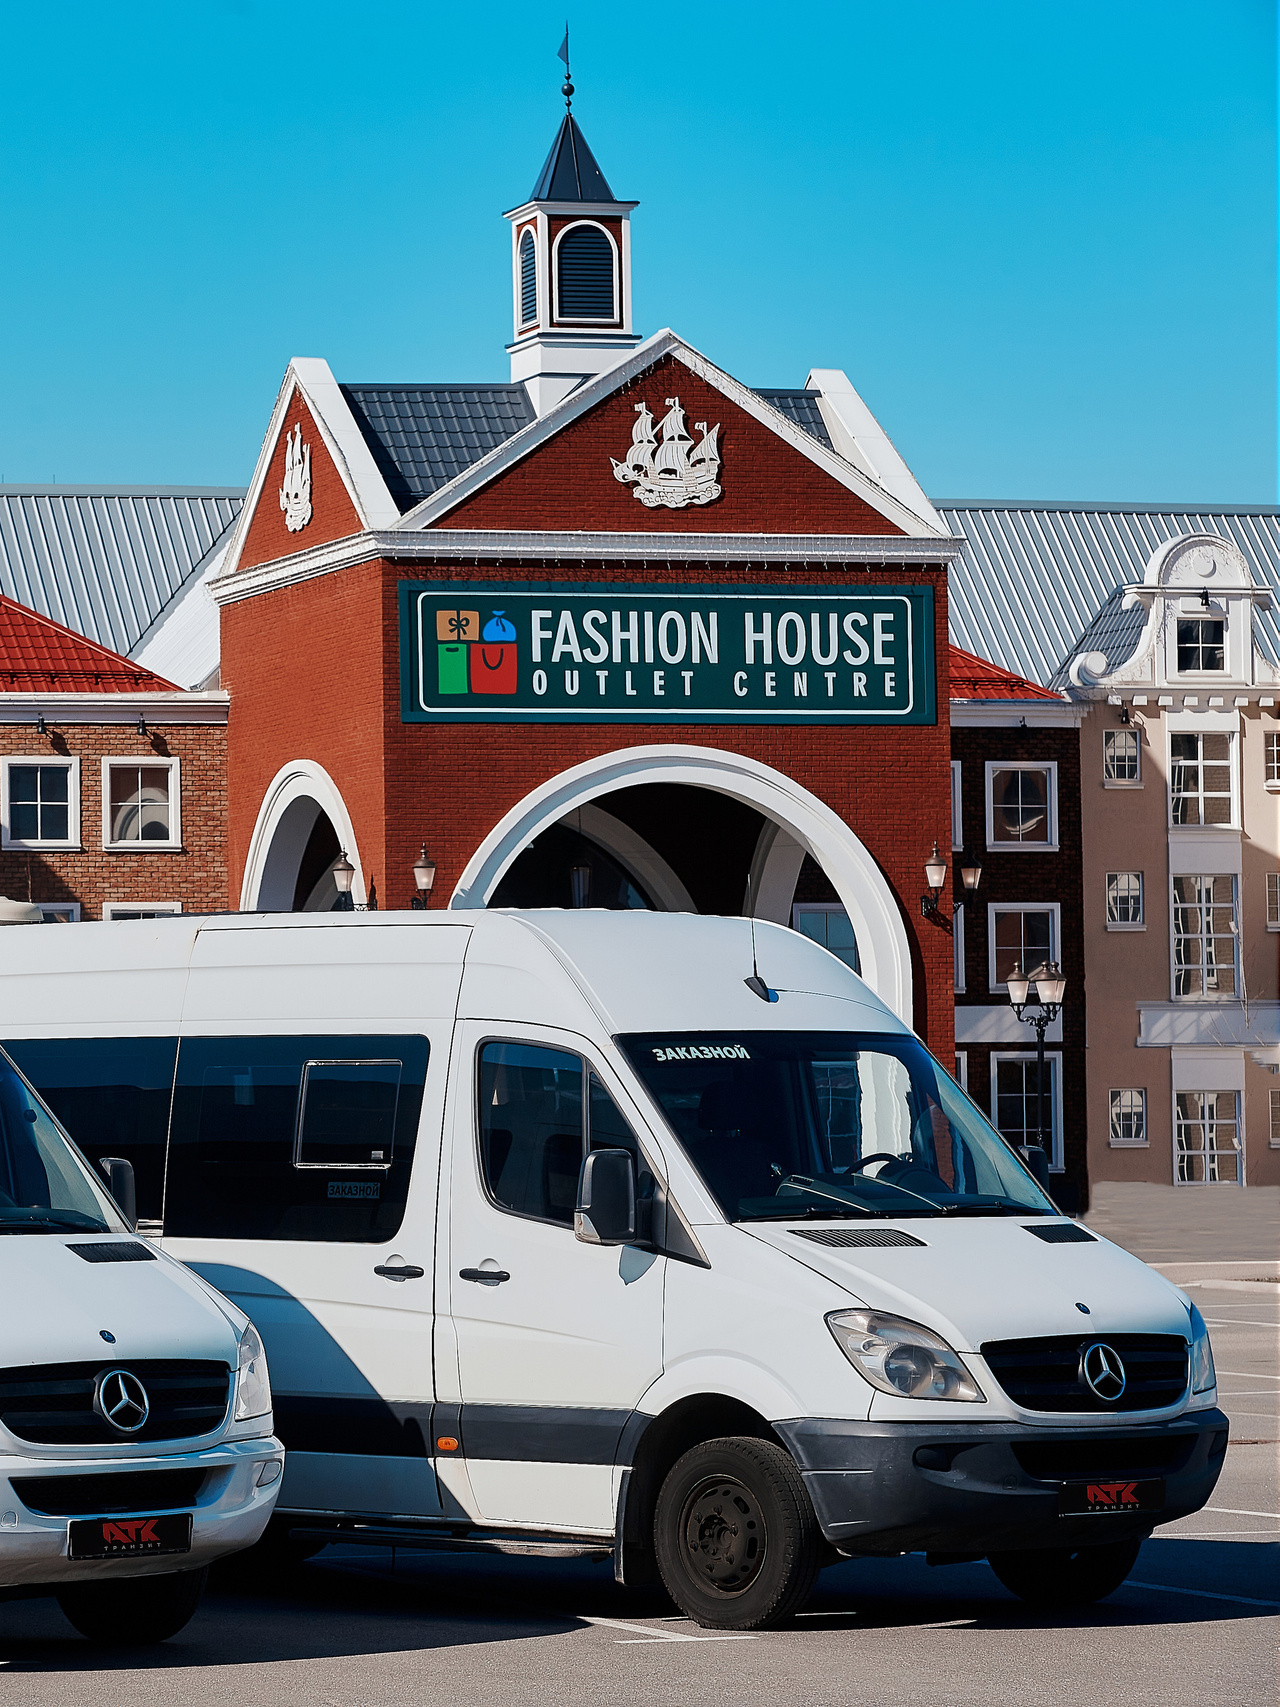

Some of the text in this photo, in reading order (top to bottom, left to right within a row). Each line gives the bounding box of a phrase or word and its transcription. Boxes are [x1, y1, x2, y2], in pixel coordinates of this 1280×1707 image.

[531, 609, 896, 665] FASHION HOUSE
[532, 670, 897, 698] OUTLET CENTRE
[652, 1044, 751, 1061] ЗАКАЗНОЙ
[329, 1183, 378, 1196] ЗАКАЗНОЙ
[104, 1543, 161, 1551] ТРАНЗИТ
